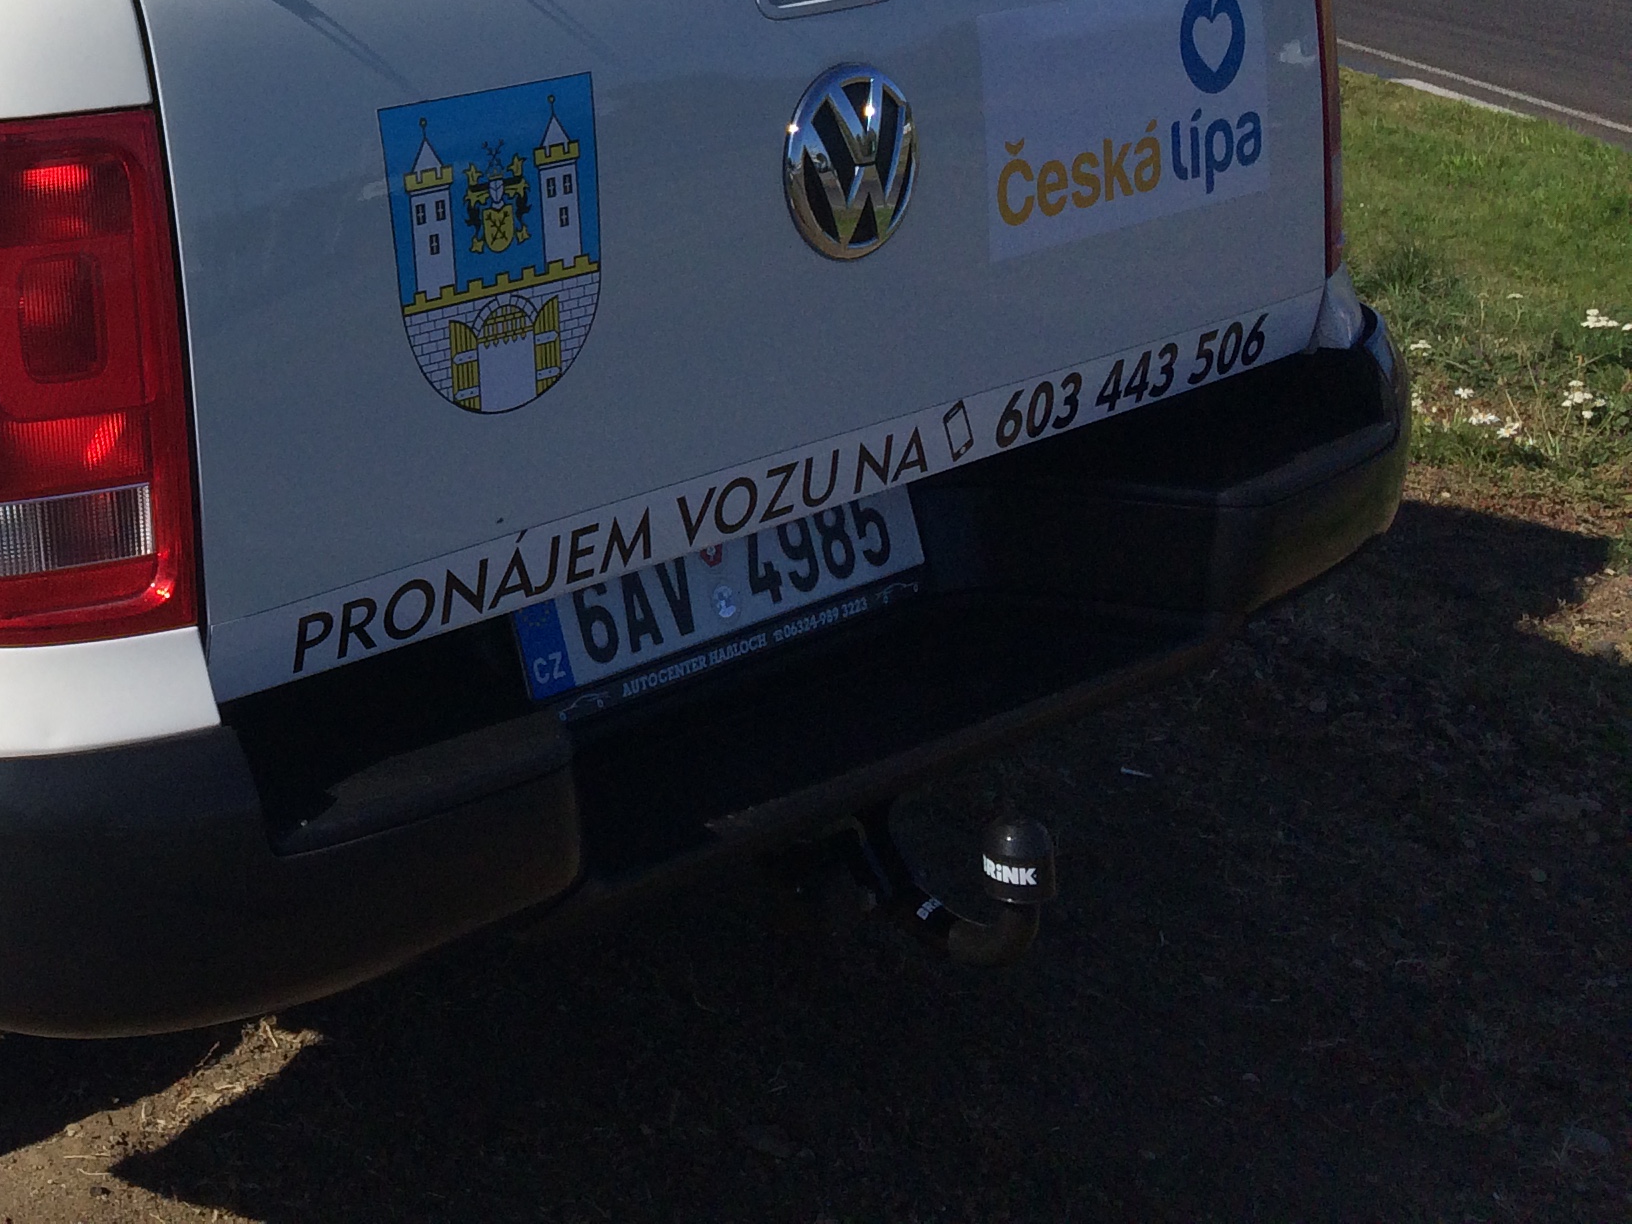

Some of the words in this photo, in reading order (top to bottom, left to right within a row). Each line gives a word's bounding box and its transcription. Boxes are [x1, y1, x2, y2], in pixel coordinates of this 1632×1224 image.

[997, 118, 1162, 227] Česká
[1171, 107, 1263, 194] lípa
[292, 507, 654, 672] PRONÁJEM
[677, 449, 840, 546] VOZU
[854, 425, 928, 490] NA
[995, 374, 1082, 449] 603
[1095, 342, 1180, 413] 443
[1187, 312, 1268, 387] 506
[572, 559, 696, 664] 6AV
[747, 497, 893, 604] 4985
[532, 652, 567, 684] CZ
[621, 654, 708, 698] AUTOCENTER
[841, 596, 868, 618] 3223
